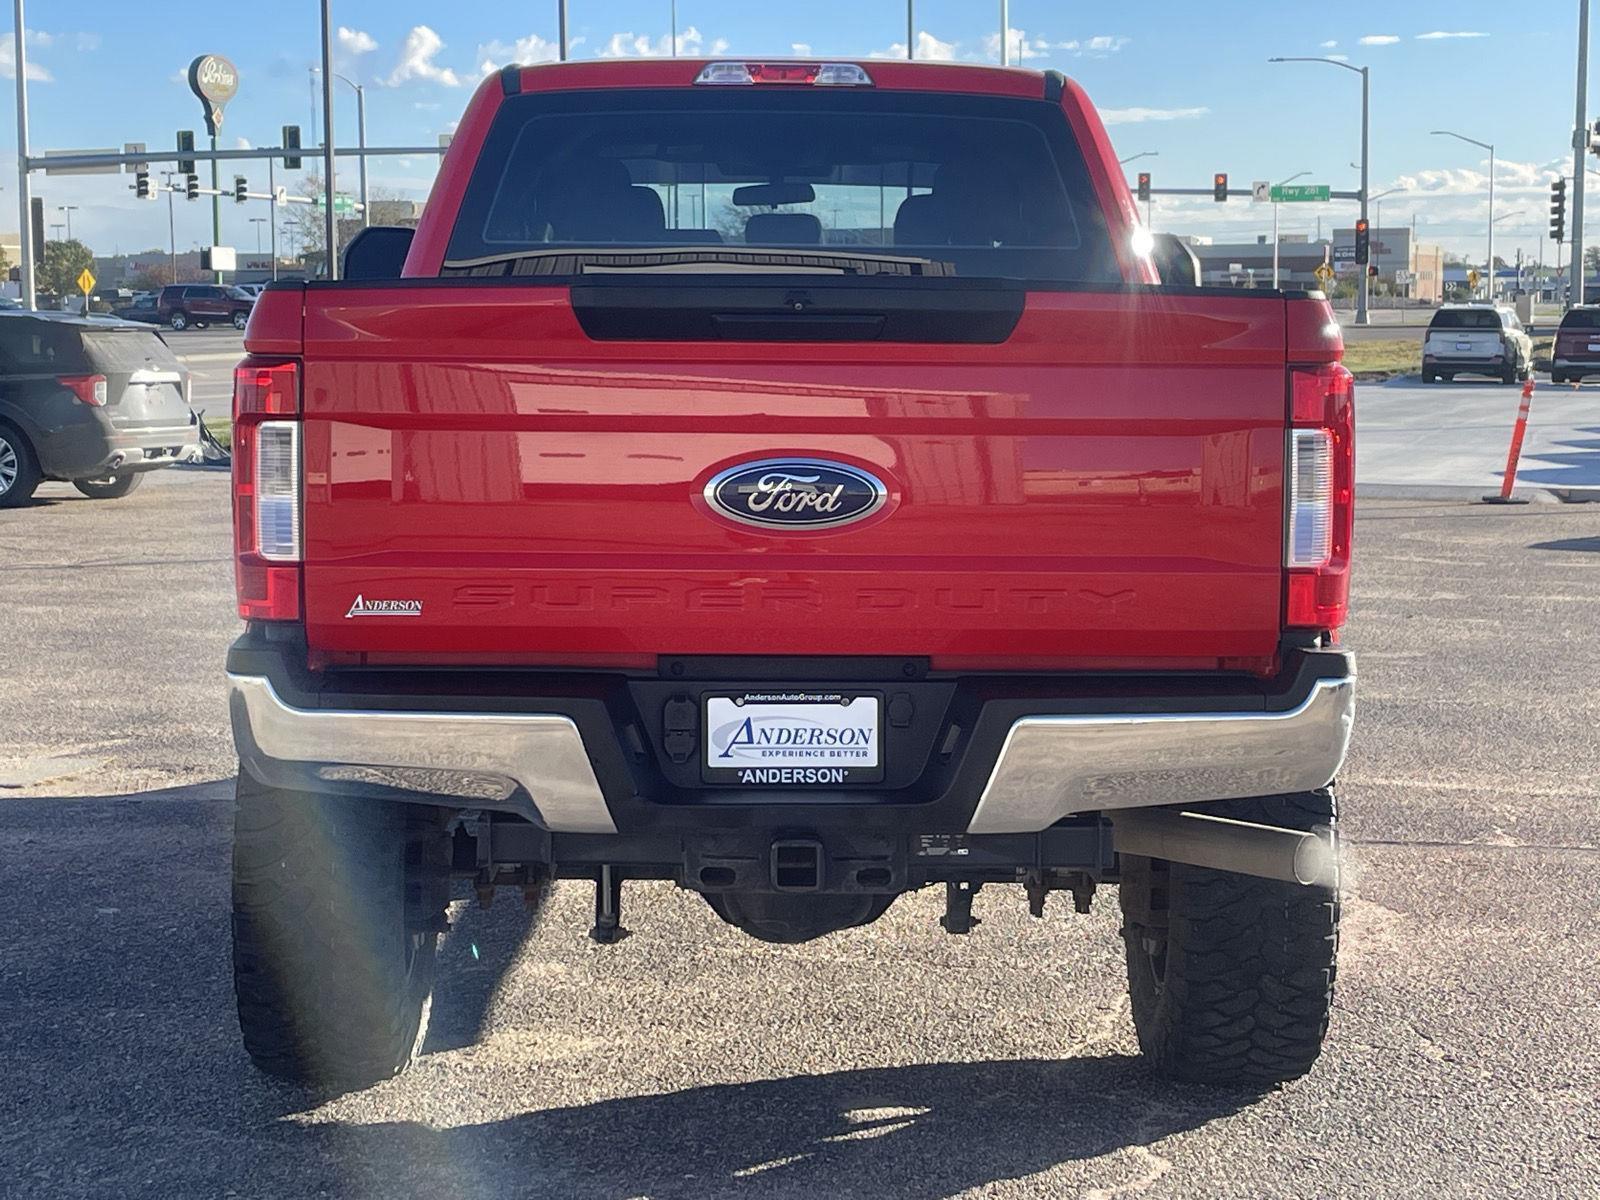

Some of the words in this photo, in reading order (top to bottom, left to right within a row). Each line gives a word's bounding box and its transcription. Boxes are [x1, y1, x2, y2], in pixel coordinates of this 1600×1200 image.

[1281, 187, 1300, 196] Hwy
[747, 473, 844, 512] Ford
[344, 594, 423, 618] ANDERSON
[452, 583, 823, 613] SUPER
[855, 587, 1137, 614] DUTY
[744, 693, 841, 702] AndersonAutoGroup.com
[718, 716, 873, 758] ANDERSON
[742, 768, 843, 783] ANDERSON
